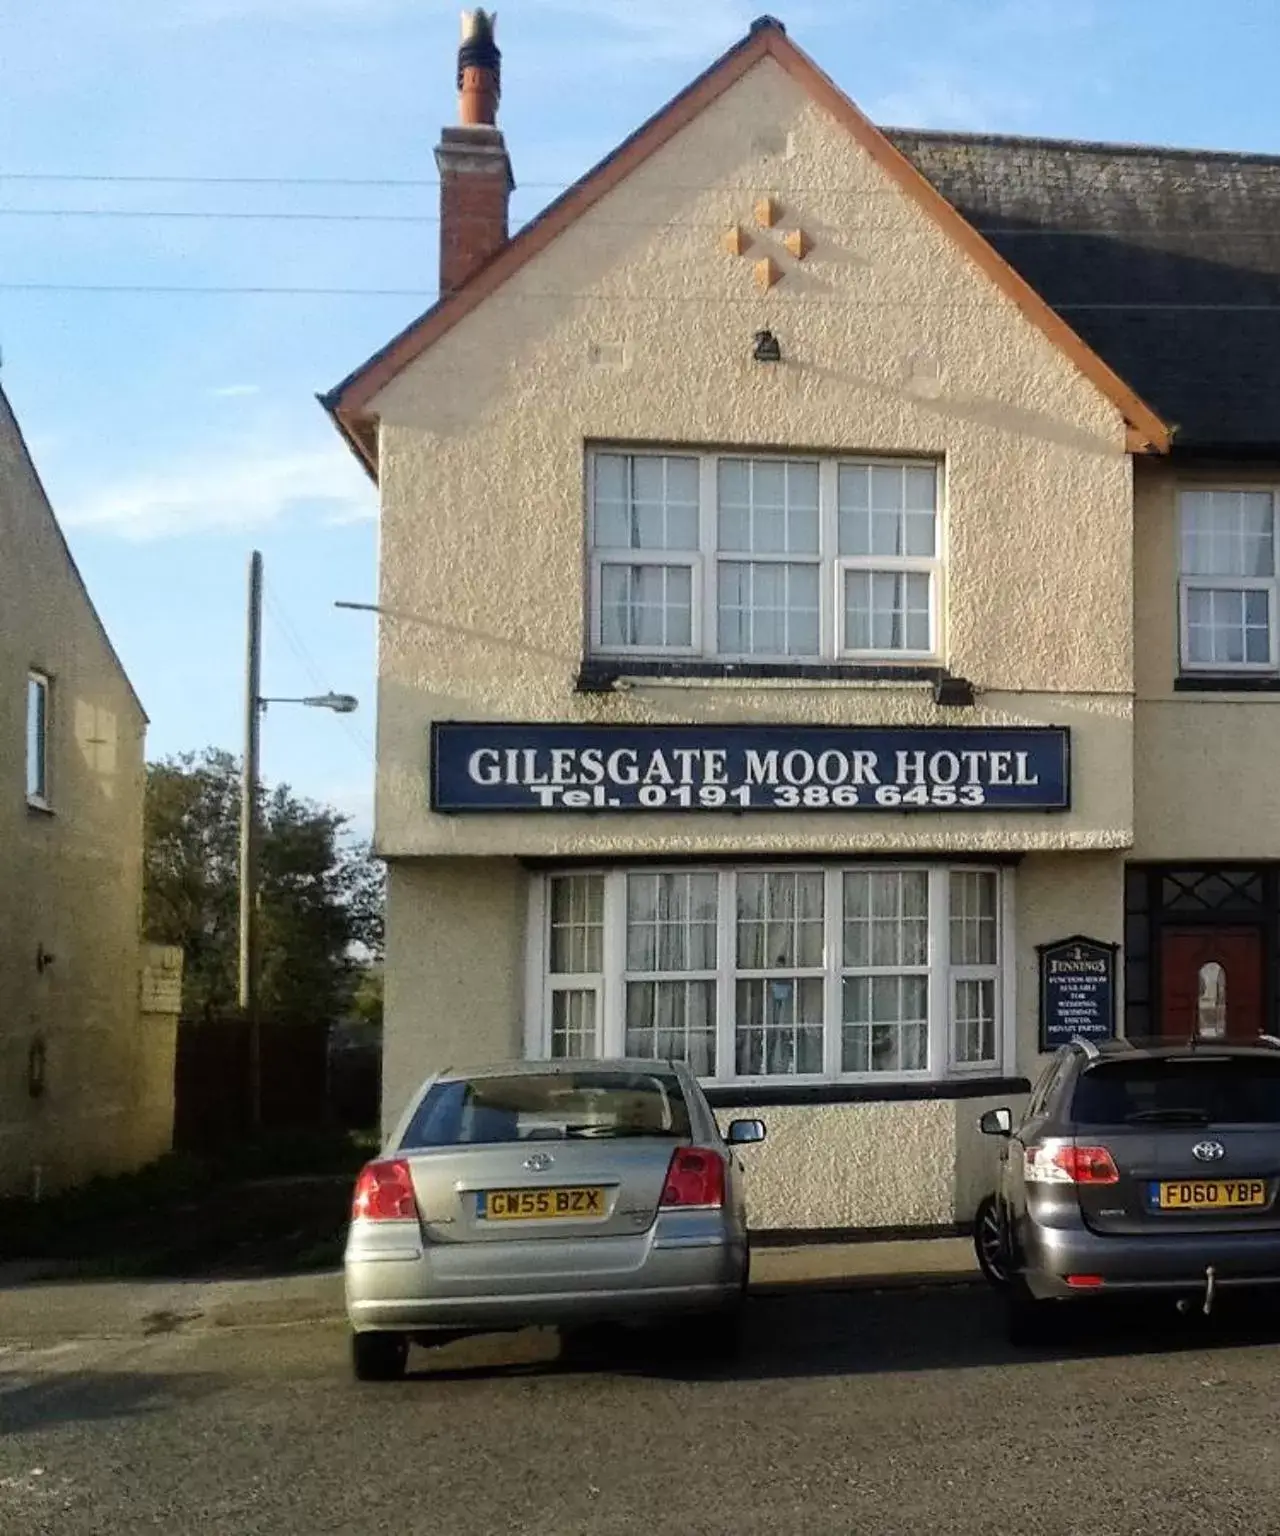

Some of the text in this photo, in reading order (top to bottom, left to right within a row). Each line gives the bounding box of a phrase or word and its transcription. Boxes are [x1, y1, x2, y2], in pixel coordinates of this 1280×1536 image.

[468, 748, 1039, 785] GILESGATE MOOR HOTEL
[530, 785, 987, 807] Tel. 0191 386 6453
[1051, 959, 1106, 973] JENNINGS
[555, 1190, 599, 1212] BZX
[1166, 1183, 1262, 1203] FD60 YBP
